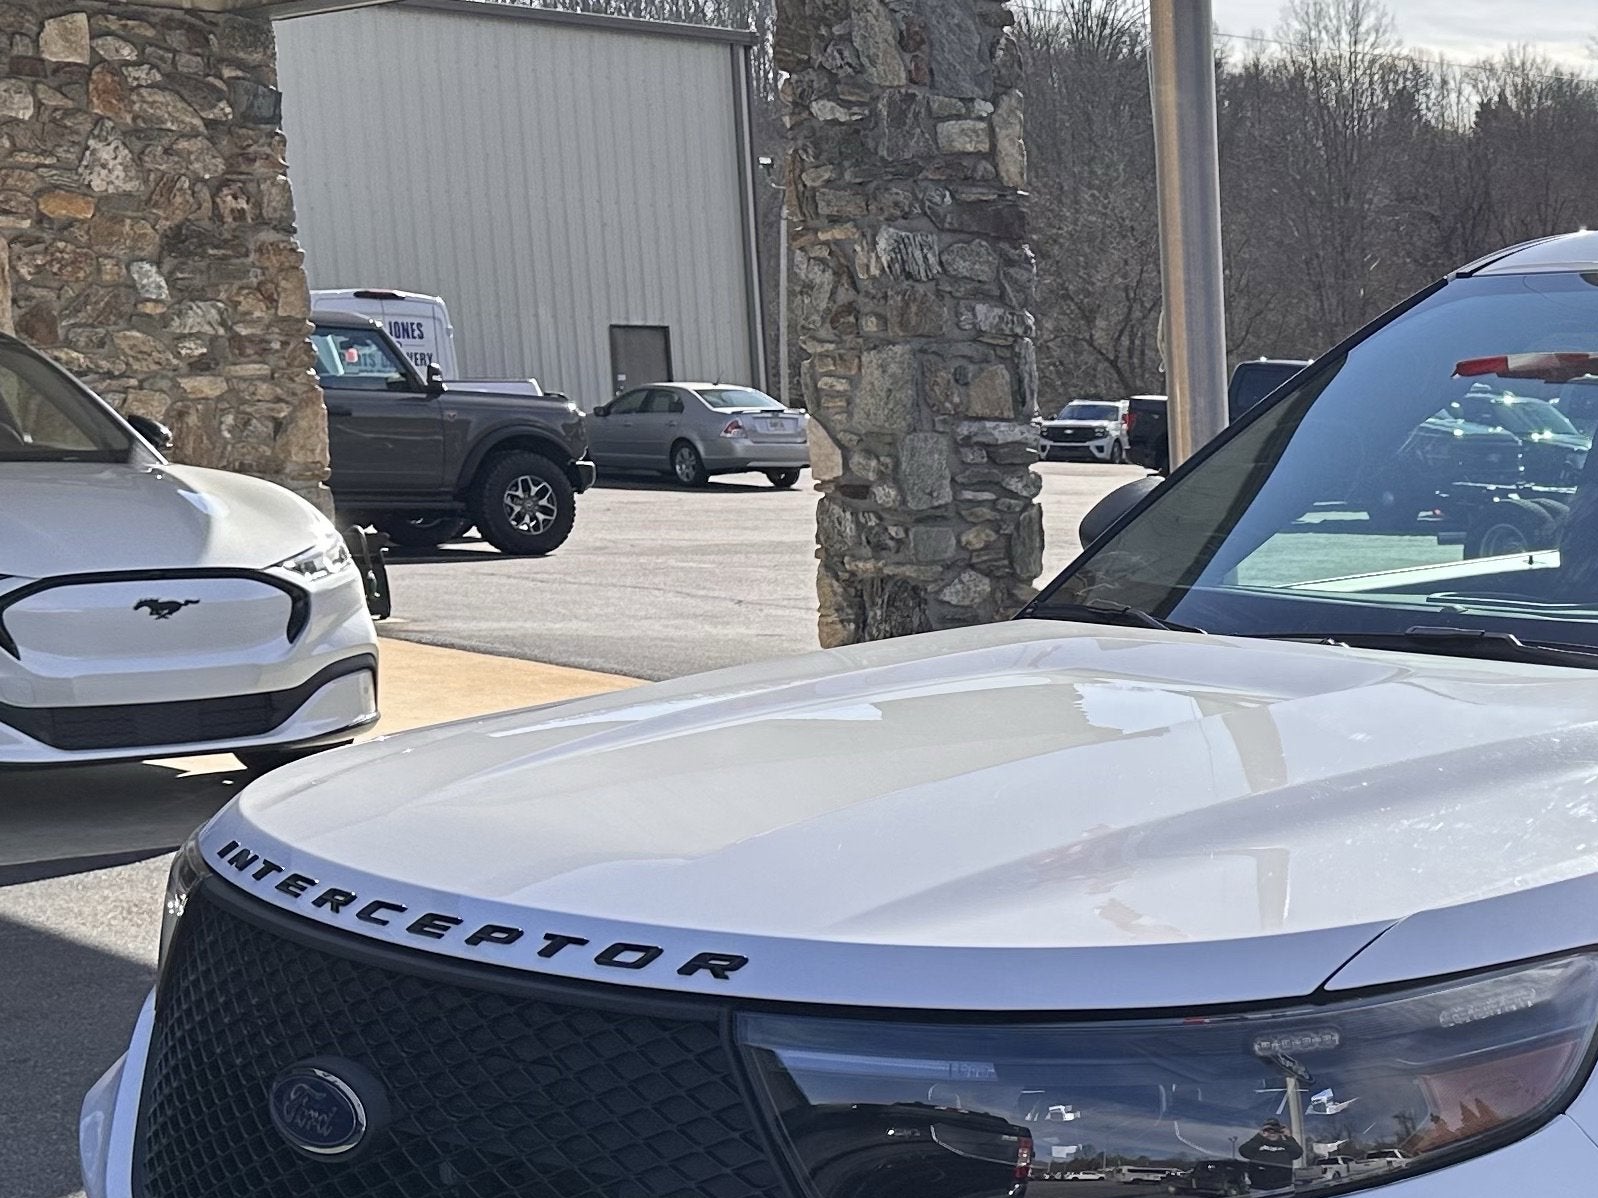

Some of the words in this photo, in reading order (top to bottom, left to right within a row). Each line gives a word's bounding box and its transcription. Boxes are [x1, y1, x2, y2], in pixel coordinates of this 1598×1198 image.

[388, 321, 424, 340] JONES
[216, 840, 750, 981] INTERCEPTOR
[283, 1083, 338, 1137] Ford
